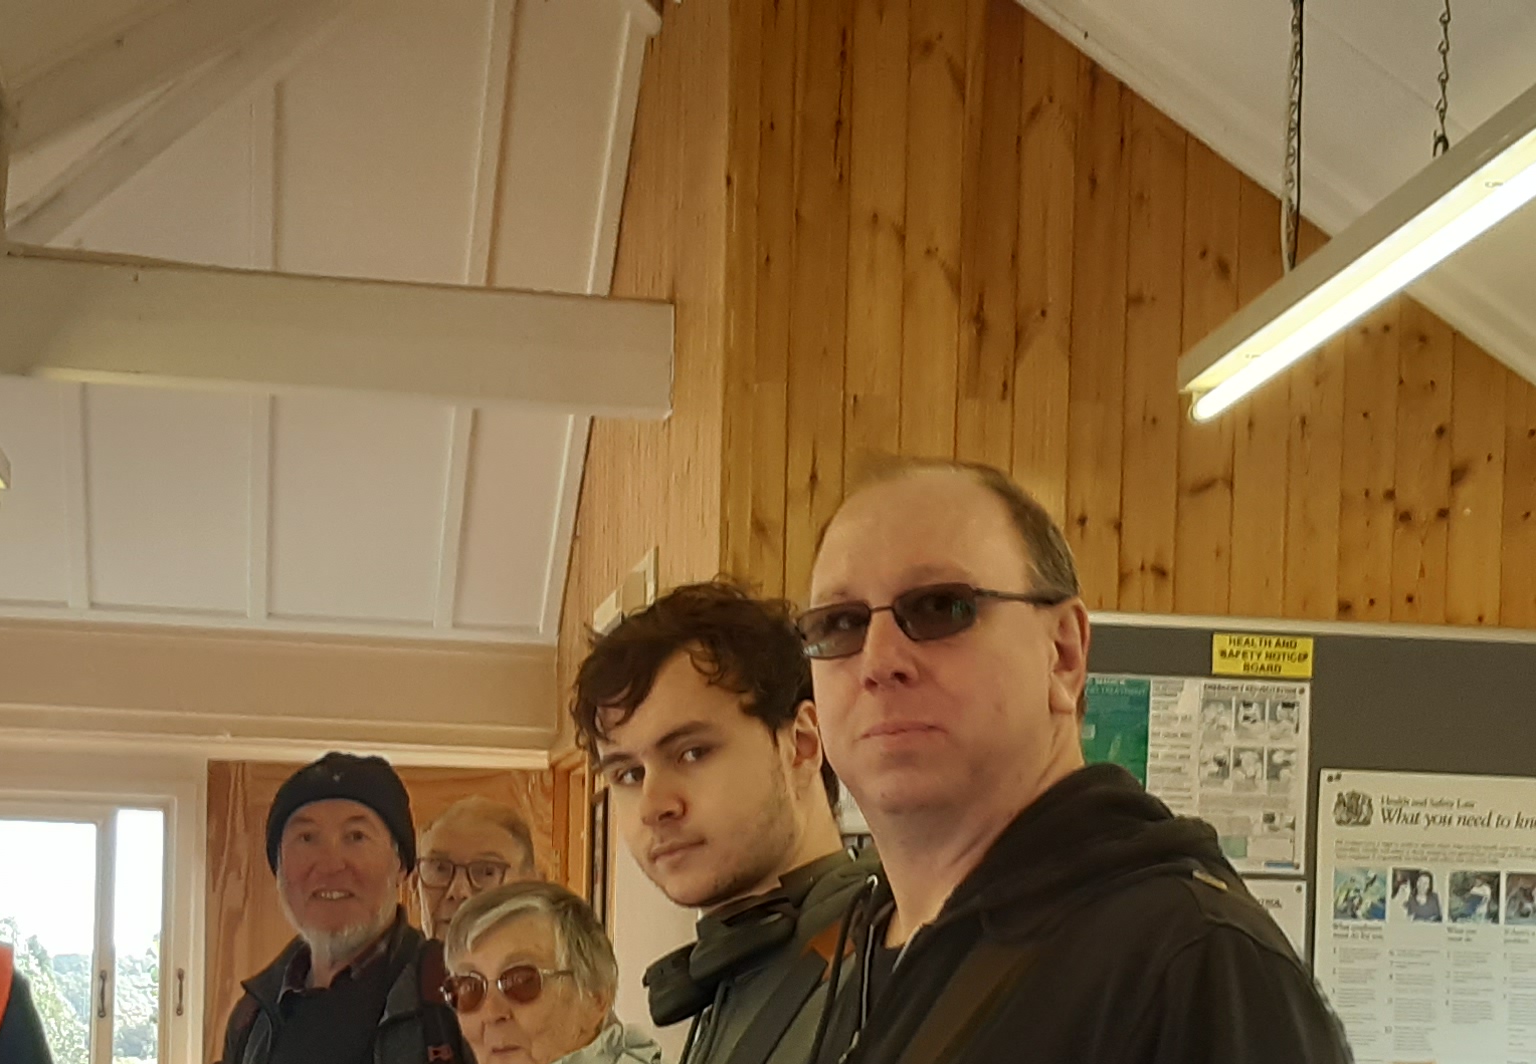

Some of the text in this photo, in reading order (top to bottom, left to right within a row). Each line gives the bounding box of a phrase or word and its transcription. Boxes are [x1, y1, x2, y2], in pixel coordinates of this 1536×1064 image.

[1228, 636, 1298, 649] HEALTH AND
[1243, 662, 1282, 673] BOARD
[1381, 807, 1420, 825] What
[1424, 813, 1452, 830] you
[1457, 810, 1493, 827] need
[1495, 814, 1512, 828] to
